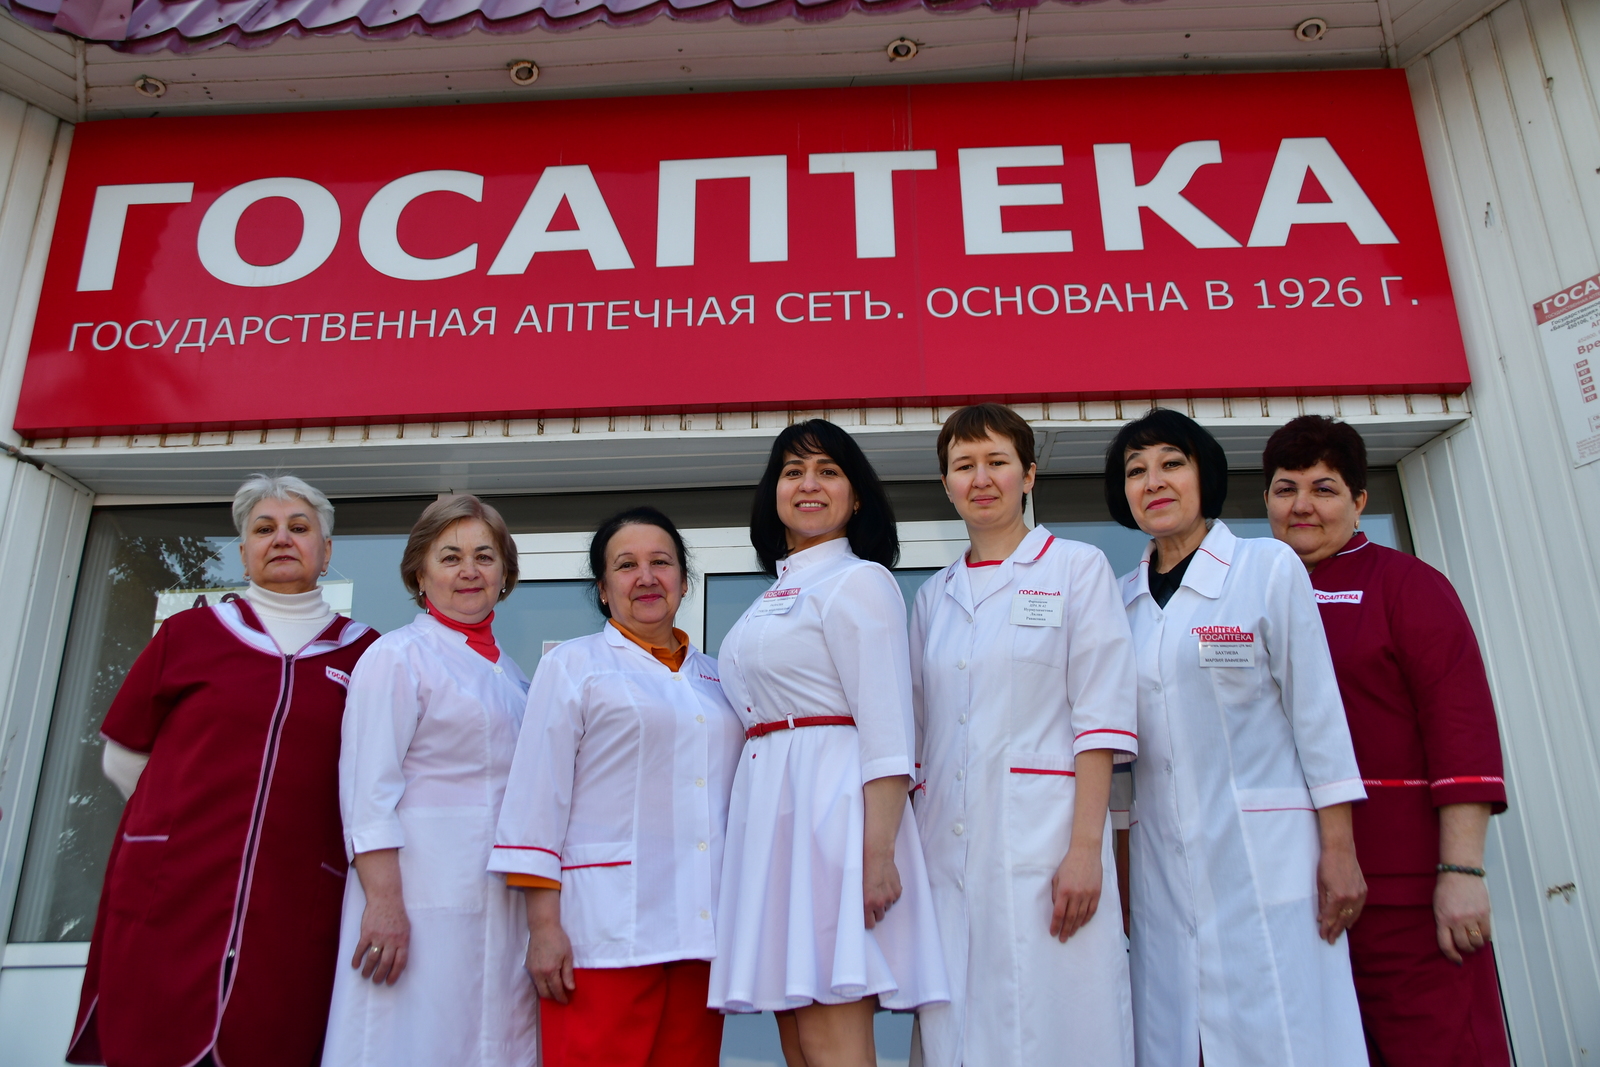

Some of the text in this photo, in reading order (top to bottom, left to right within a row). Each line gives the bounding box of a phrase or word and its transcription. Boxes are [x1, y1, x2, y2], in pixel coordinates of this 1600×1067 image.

[77, 138, 1399, 291] ГОСАПТЕКА
[1541, 275, 1600, 314] ГОСА
[69, 277, 1417, 352] ГОСУДАРСТВЕННАЯ АПТЕЧНАЯ СЕТЬ. ОСНОВАНА В 1926 Г.
[1192, 626, 1241, 634] ГОСАПТЕКА
[1200, 633, 1252, 641] ГОСАПТЕКА
